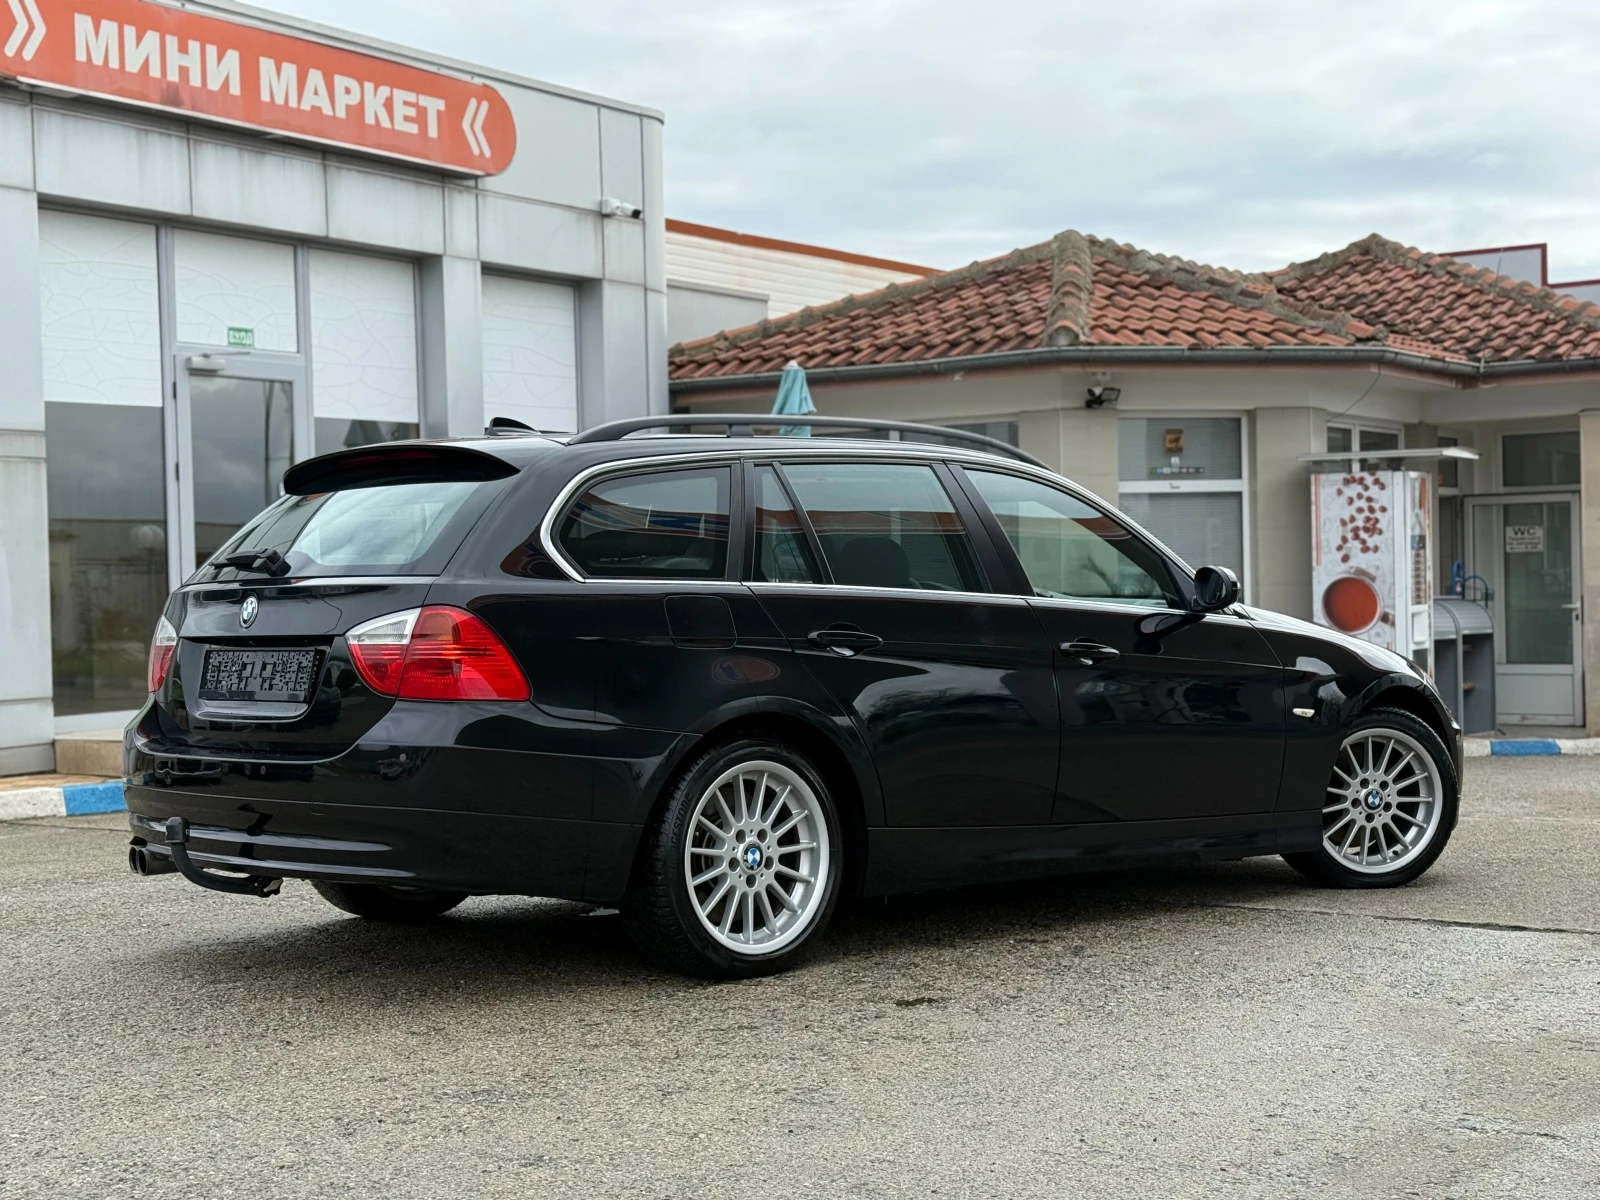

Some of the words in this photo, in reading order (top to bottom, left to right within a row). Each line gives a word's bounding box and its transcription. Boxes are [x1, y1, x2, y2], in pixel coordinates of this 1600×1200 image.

[74, 13, 241, 96] МИНИ
[259, 57, 446, 139] МАРКЕТ
[1512, 526, 1536, 536] WC
